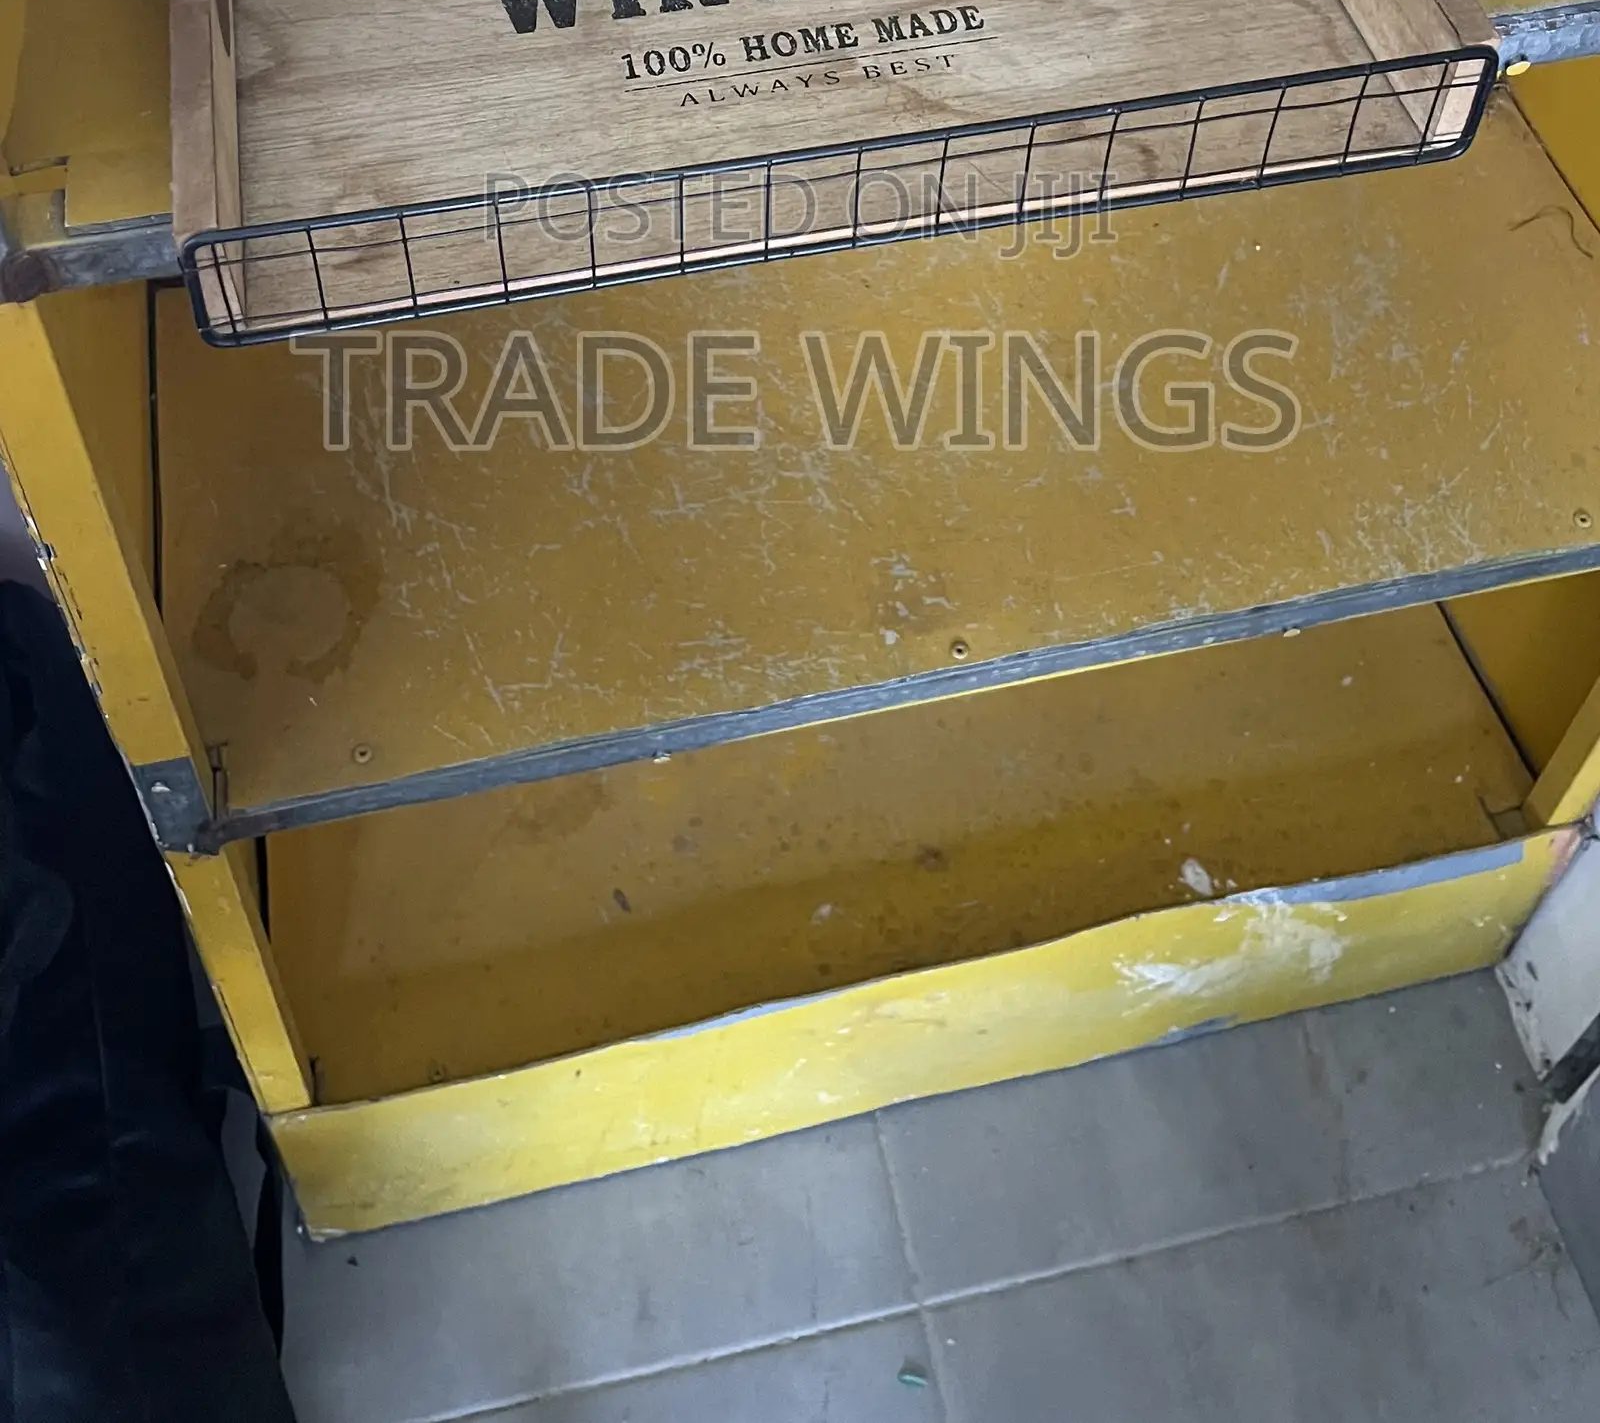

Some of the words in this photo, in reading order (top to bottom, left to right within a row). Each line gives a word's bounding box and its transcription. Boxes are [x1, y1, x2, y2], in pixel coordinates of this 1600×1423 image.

[622, 41, 726, 80] 100%
[739, 21, 860, 62] HOME
[876, 5, 985, 44] MADE
[679, 70, 841, 108] ALWAYS
[862, 53, 956, 80] BEST
